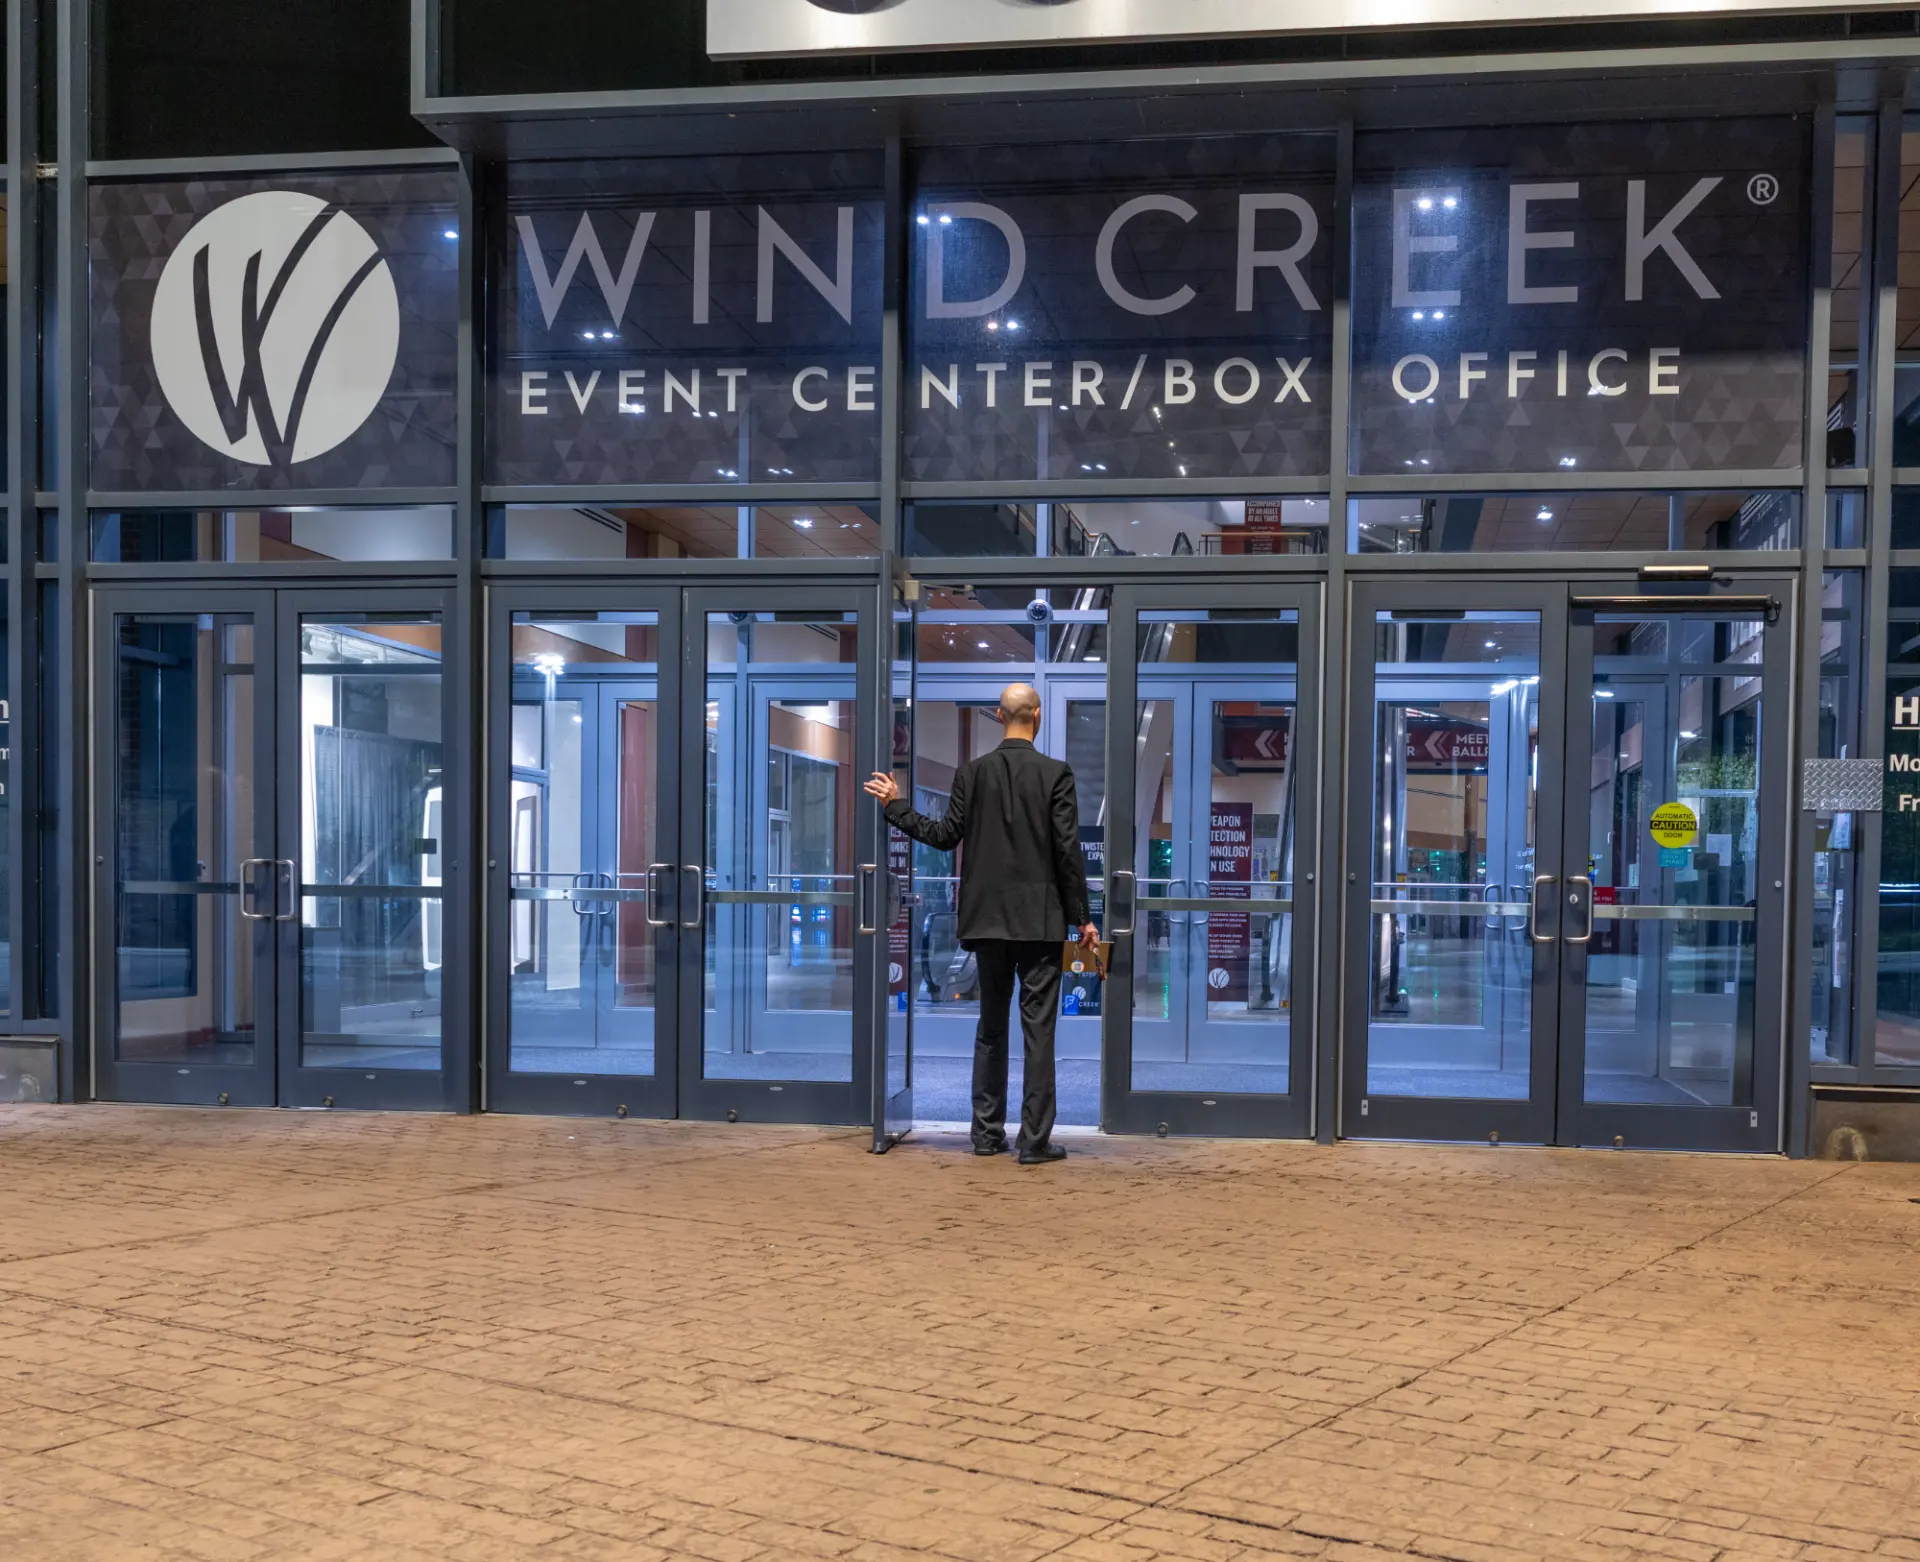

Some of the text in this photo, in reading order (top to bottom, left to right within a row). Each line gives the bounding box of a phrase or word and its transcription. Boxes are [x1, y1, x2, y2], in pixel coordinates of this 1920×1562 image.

[515, 202, 1026, 331] WIND
[1095, 176, 1724, 315] CREEK
[521, 368, 748, 415] EVENT
[1392, 347, 1681, 401] OFFICE
[1210, 815, 1241, 828] EAPON
[1651, 821, 1697, 830] CAUTION
[1218, 861, 1236, 873] USE
